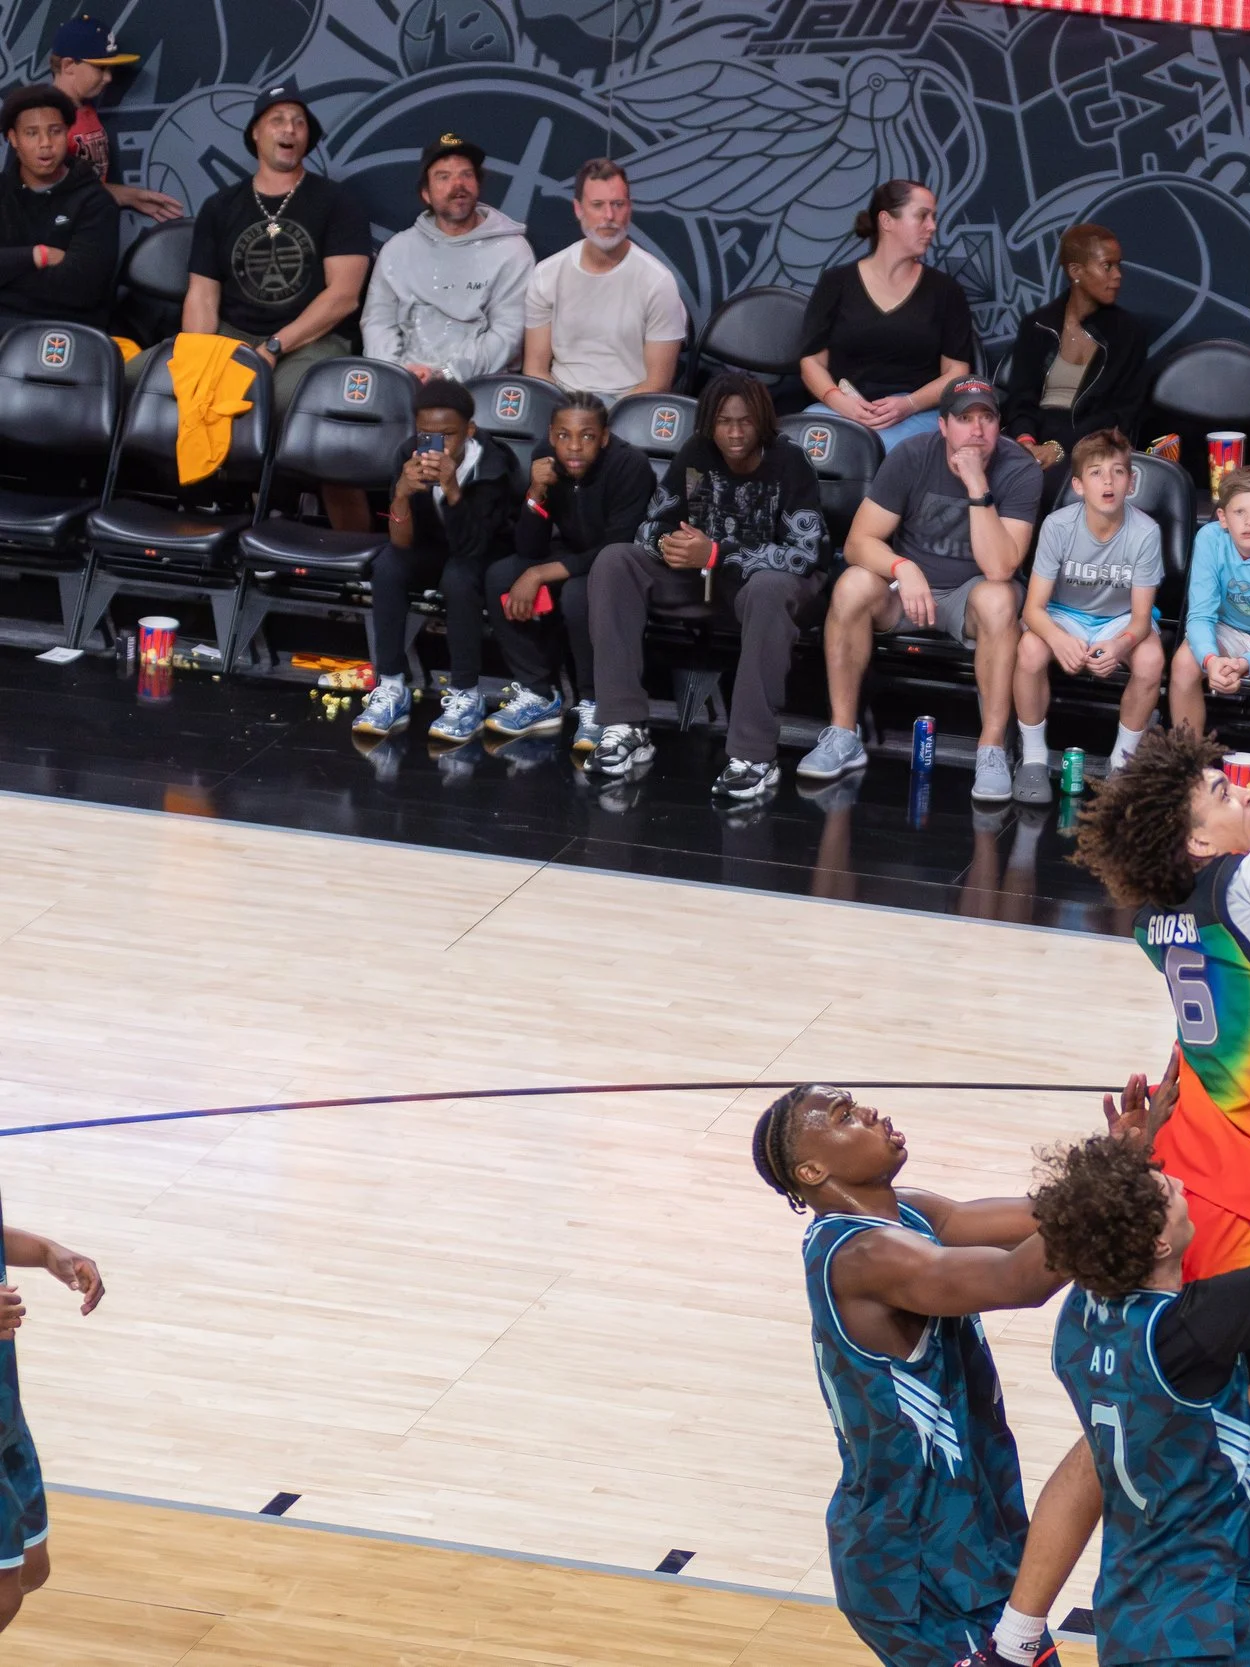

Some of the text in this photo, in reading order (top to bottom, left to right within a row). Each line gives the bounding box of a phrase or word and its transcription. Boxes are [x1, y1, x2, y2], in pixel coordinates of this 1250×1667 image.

[1065, 560, 1132, 581] TIGERS
[925, 735, 934, 767] ULTRA
[1165, 945, 1218, 1045] 6
[1091, 1400, 1148, 1511] 7
